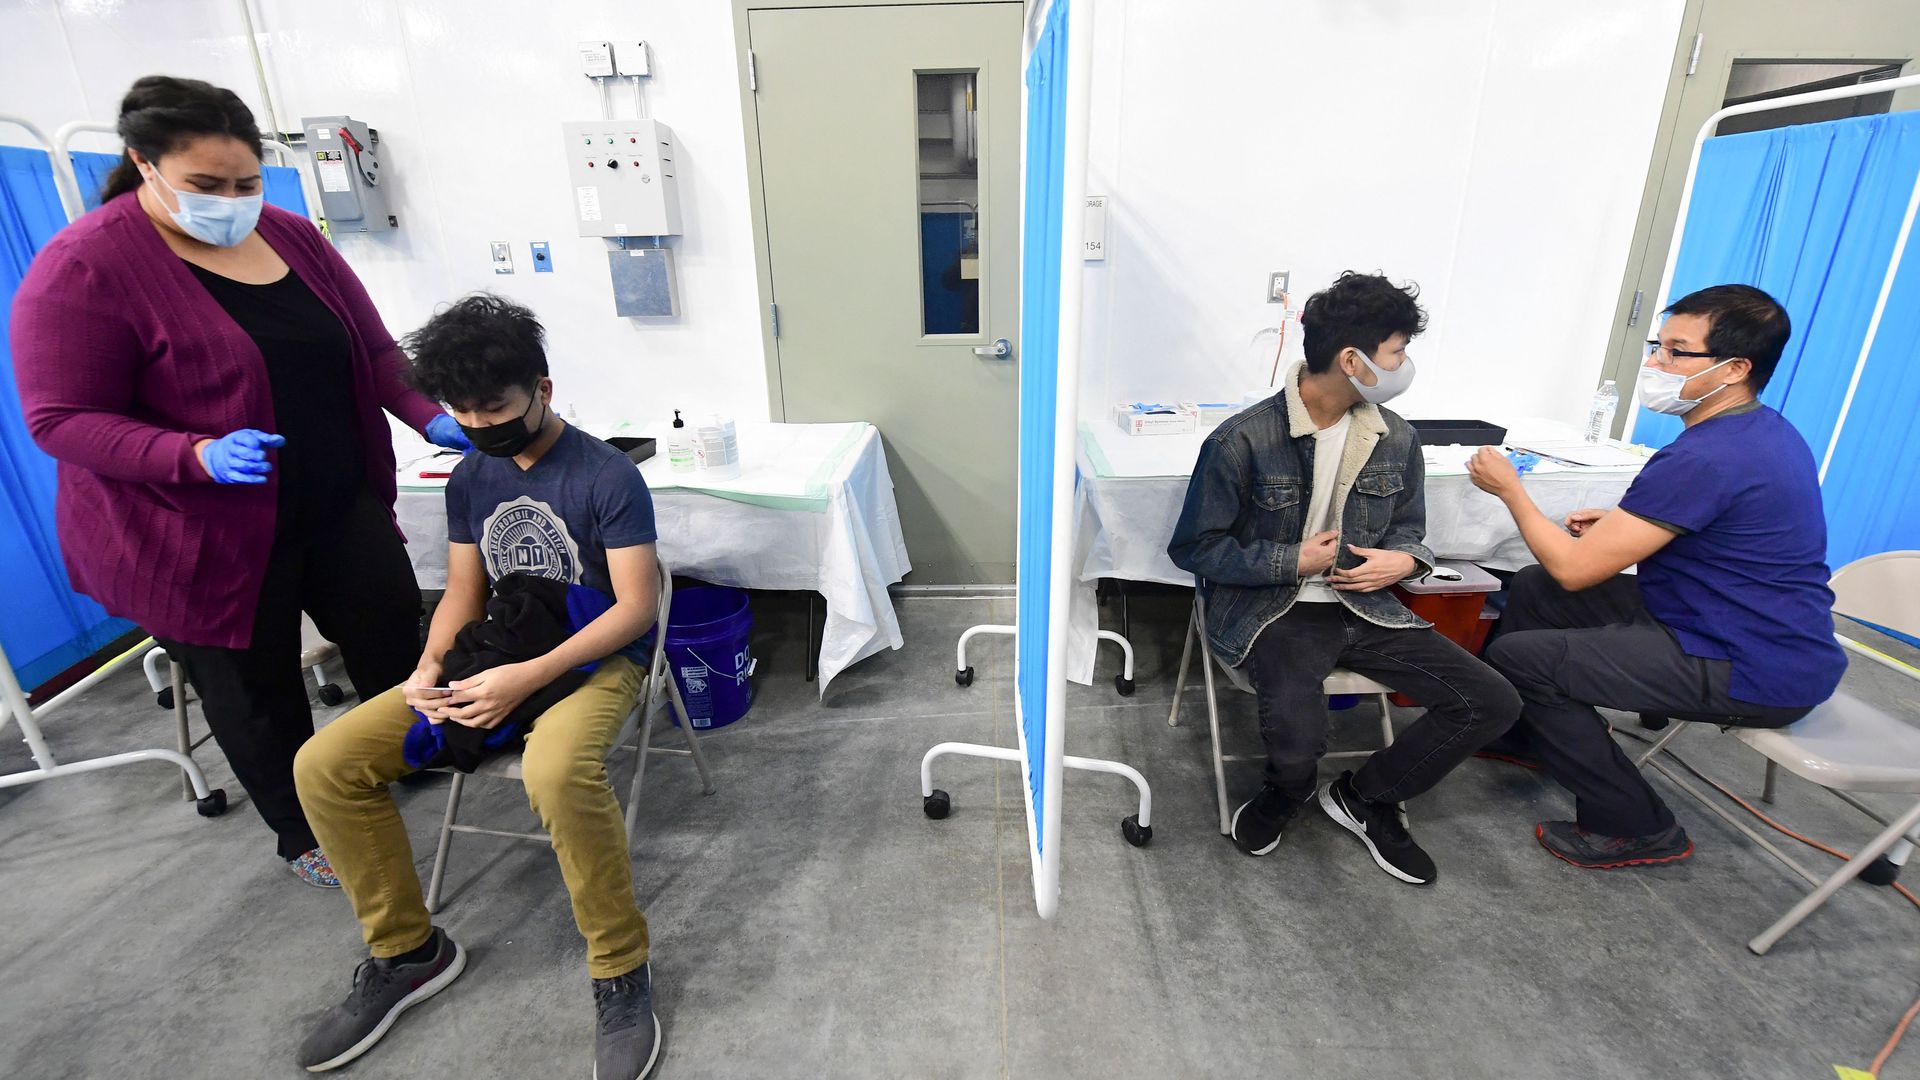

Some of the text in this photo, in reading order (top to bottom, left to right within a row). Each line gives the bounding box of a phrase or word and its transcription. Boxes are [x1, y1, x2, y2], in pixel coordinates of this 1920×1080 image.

[1085, 242, 1101, 250] 154
[491, 510, 567, 554] ABERCROMBIE AND FITCH
